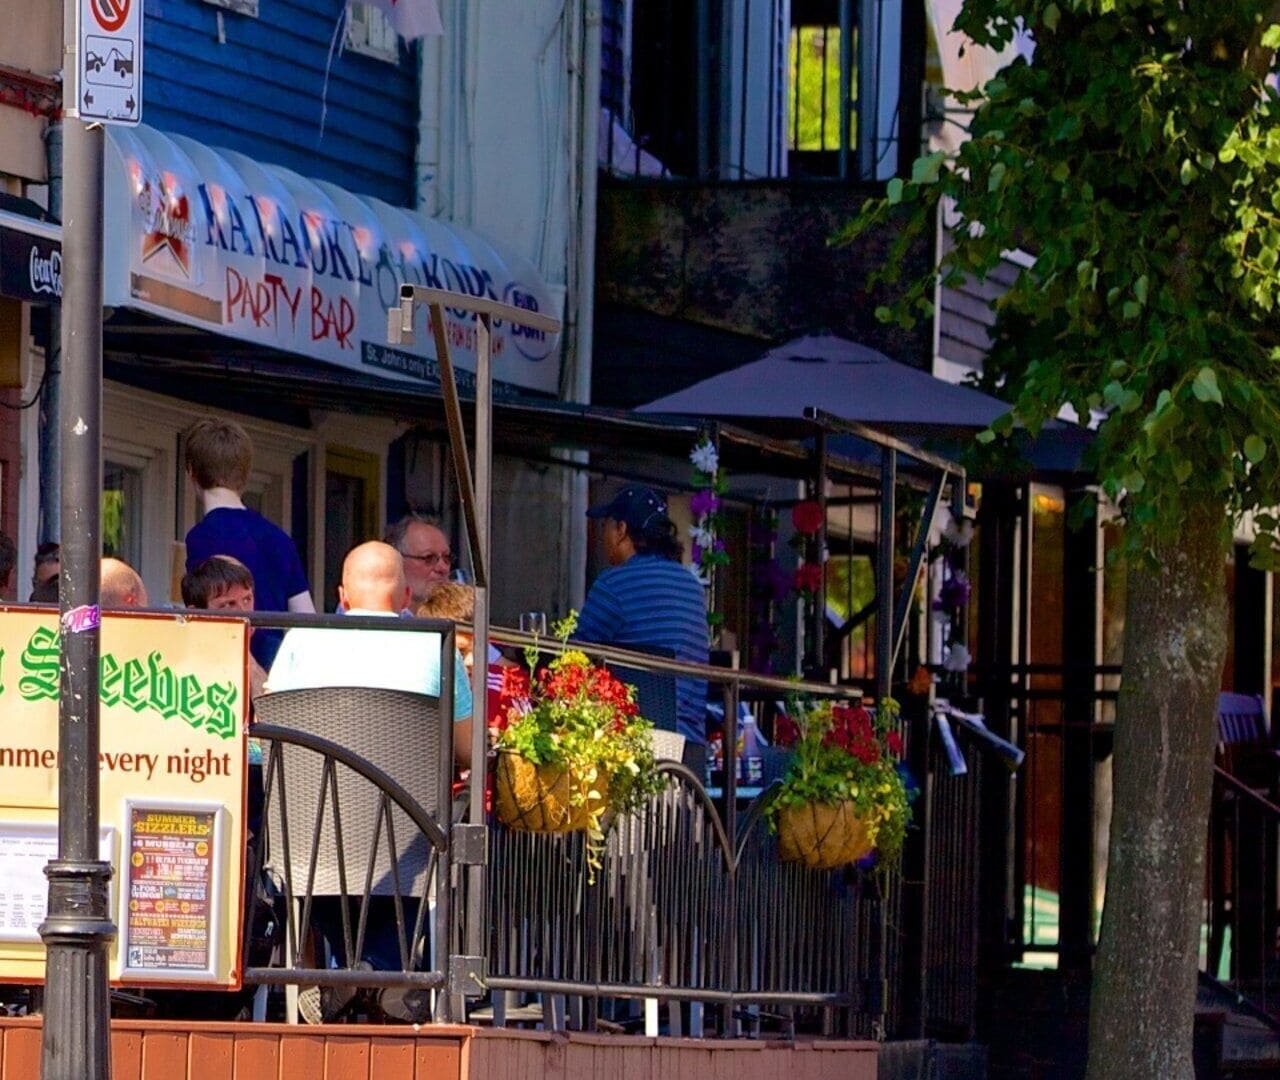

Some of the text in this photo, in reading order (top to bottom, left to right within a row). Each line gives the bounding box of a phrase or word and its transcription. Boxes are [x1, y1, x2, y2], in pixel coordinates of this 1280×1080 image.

[226, 266, 302, 340] PARTY
[312, 286, 355, 350] BAR
[99, 754, 158, 781] every
[167, 748, 232, 783] night
[135, 821, 207, 835] SIZZLERS
